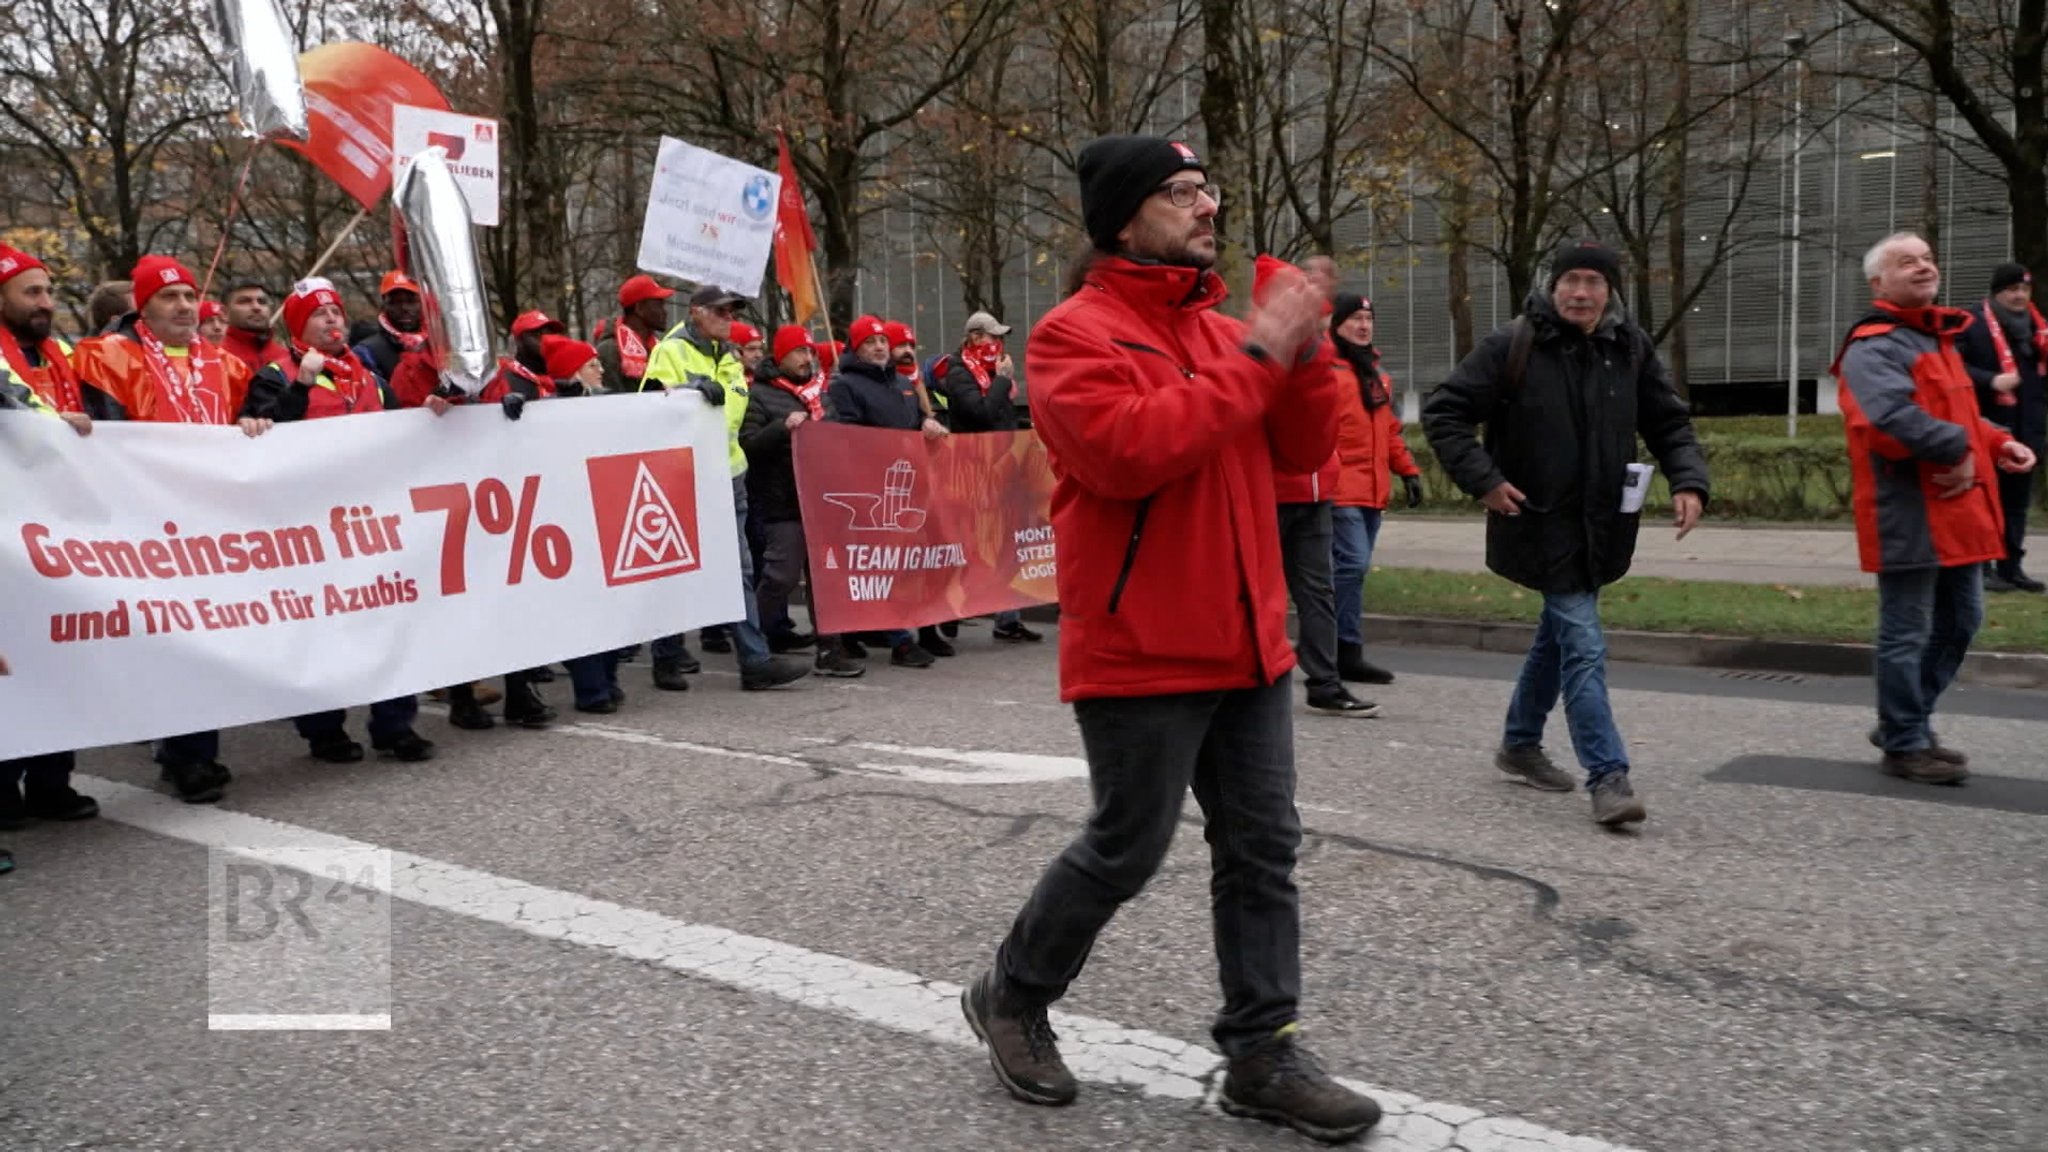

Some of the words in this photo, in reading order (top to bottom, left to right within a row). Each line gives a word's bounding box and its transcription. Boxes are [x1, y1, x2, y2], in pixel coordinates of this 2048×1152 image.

[445, 161, 494, 179] RLIEBEN
[718, 212, 736, 225] wir
[21, 521, 326, 580] Gemeinsam
[329, 505, 403, 558] für
[409, 474, 573, 596] 7%
[846, 544, 900, 571] TEAM
[902, 546, 924, 570] IG
[922, 543, 968, 570] METALL
[849, 574, 894, 602] BMW
[50, 600, 130, 643] und
[137, 600, 195, 635] 170
[198, 598, 270, 630] Euro
[270, 588, 316, 621] für
[324, 570, 419, 616] Azubis
